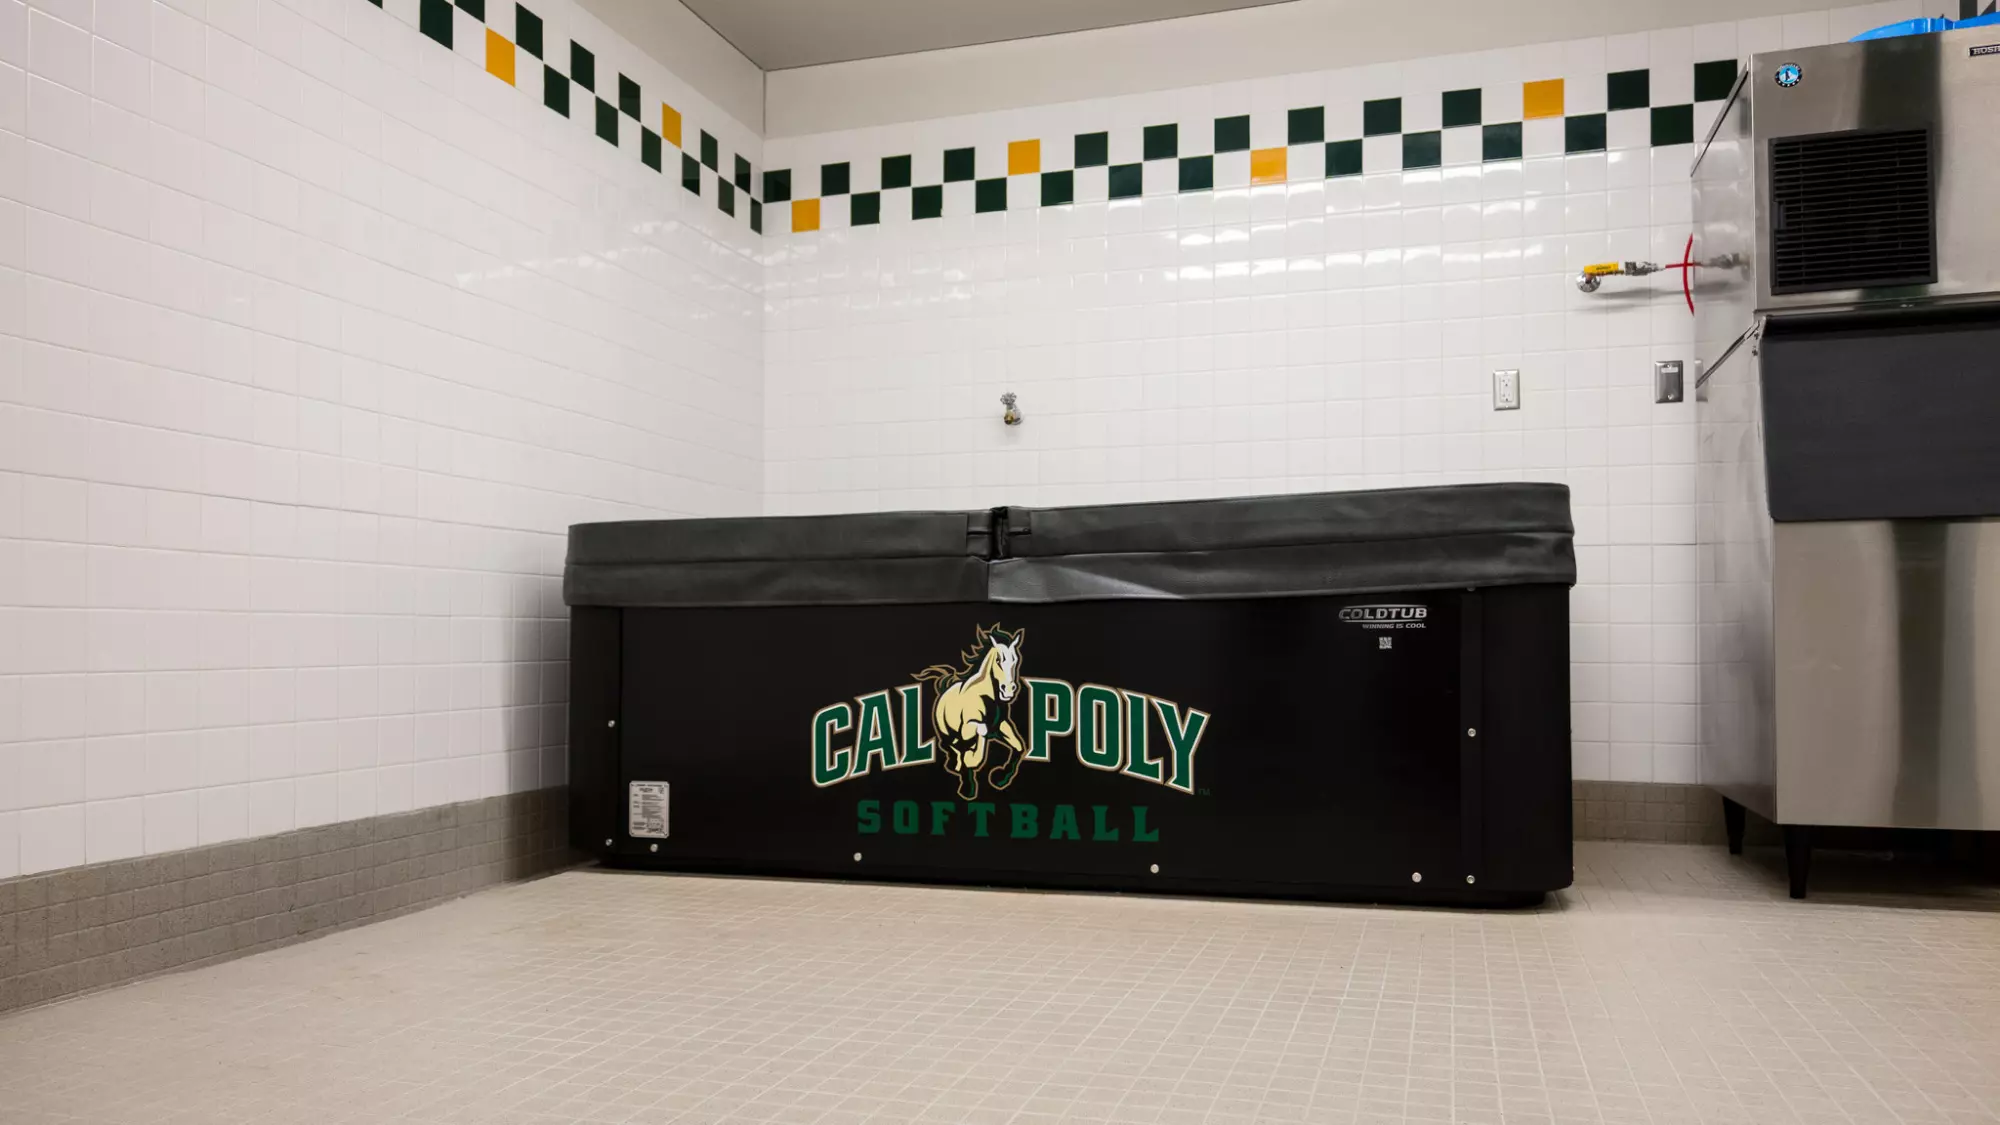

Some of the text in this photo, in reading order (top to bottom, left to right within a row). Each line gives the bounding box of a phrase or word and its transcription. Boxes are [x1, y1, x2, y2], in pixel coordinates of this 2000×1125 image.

[1338, 607, 1428, 619] COLDTUB
[811, 675, 1211, 794] CAL POLY
[857, 799, 1160, 842] SOFTBALL
